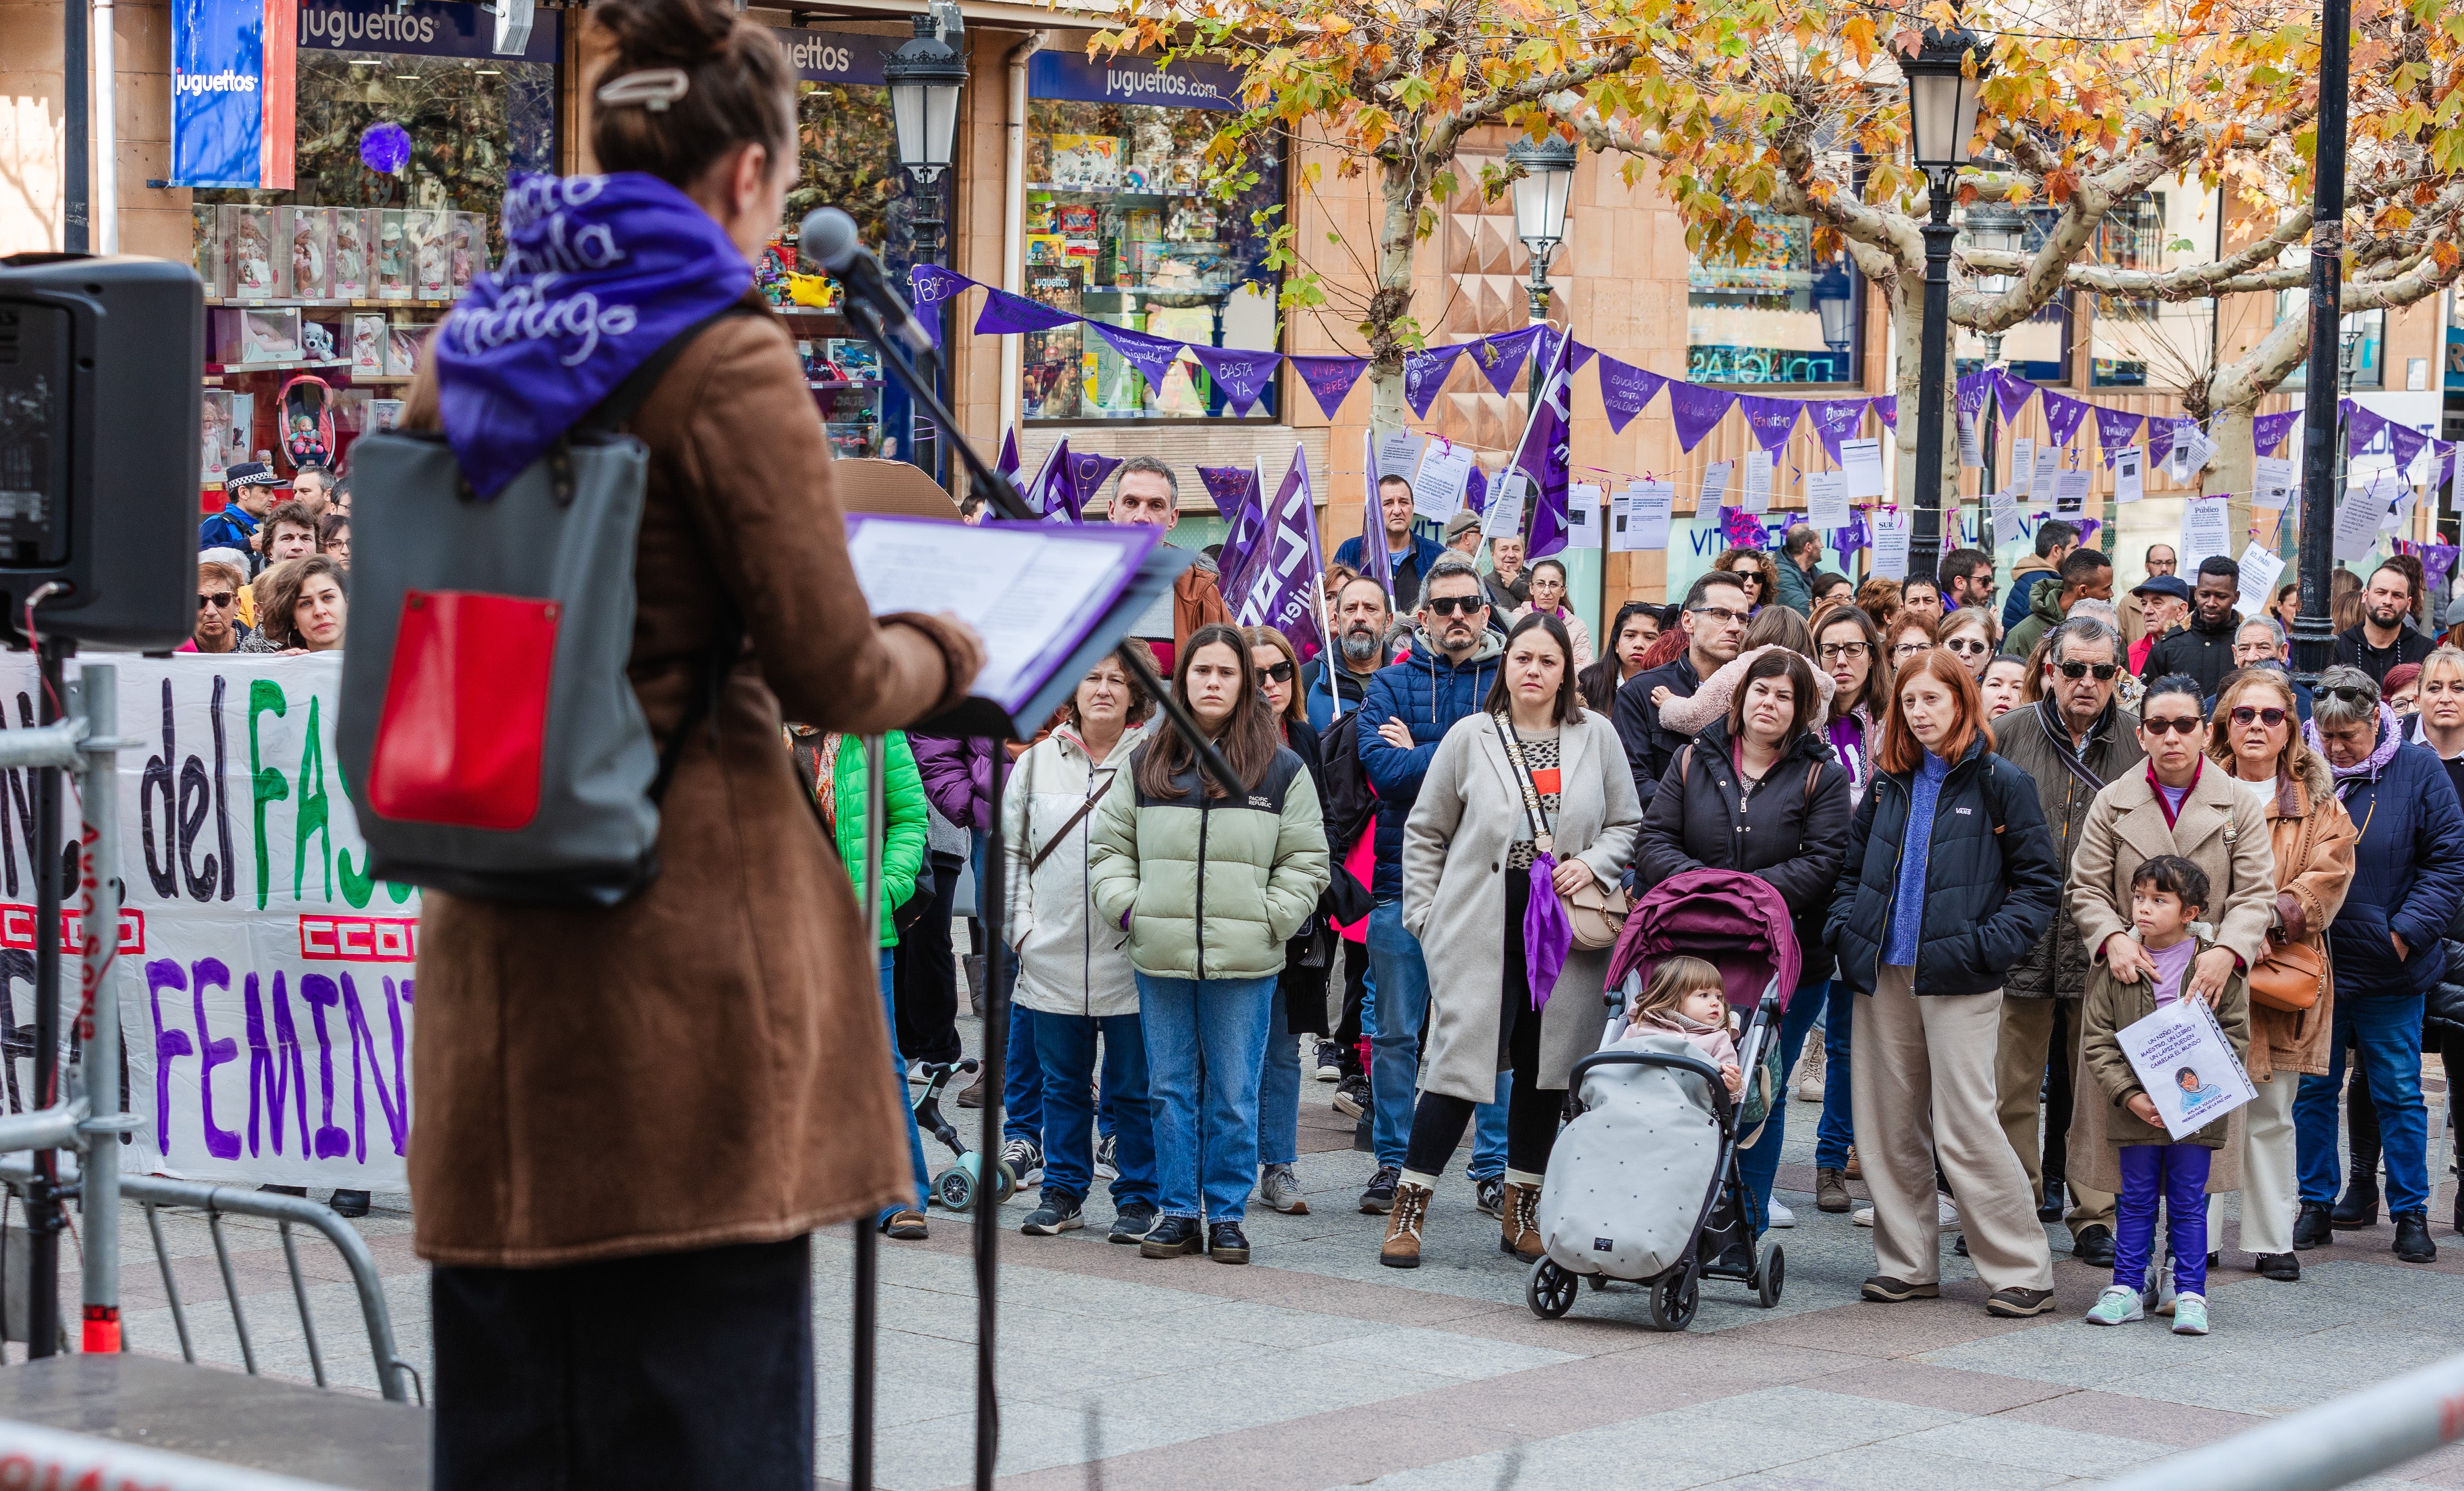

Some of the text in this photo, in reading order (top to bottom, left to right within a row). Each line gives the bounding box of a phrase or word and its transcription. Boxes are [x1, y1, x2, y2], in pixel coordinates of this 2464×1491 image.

[1219, 362, 1254, 380] BASTA
[1231, 380, 1253, 397] YA
[2249, 550, 2259, 559] EL
[142, 676, 235, 903] del
[2175, 1026, 2192, 1038] LIBRO
[2150, 1053, 2175, 1069] CAMBIAR
[2181, 1038, 2202, 1051] MUNDO
[2157, 1044, 2175, 1056] LÁPIZ
[2174, 1033, 2195, 1047] PUEDEN
